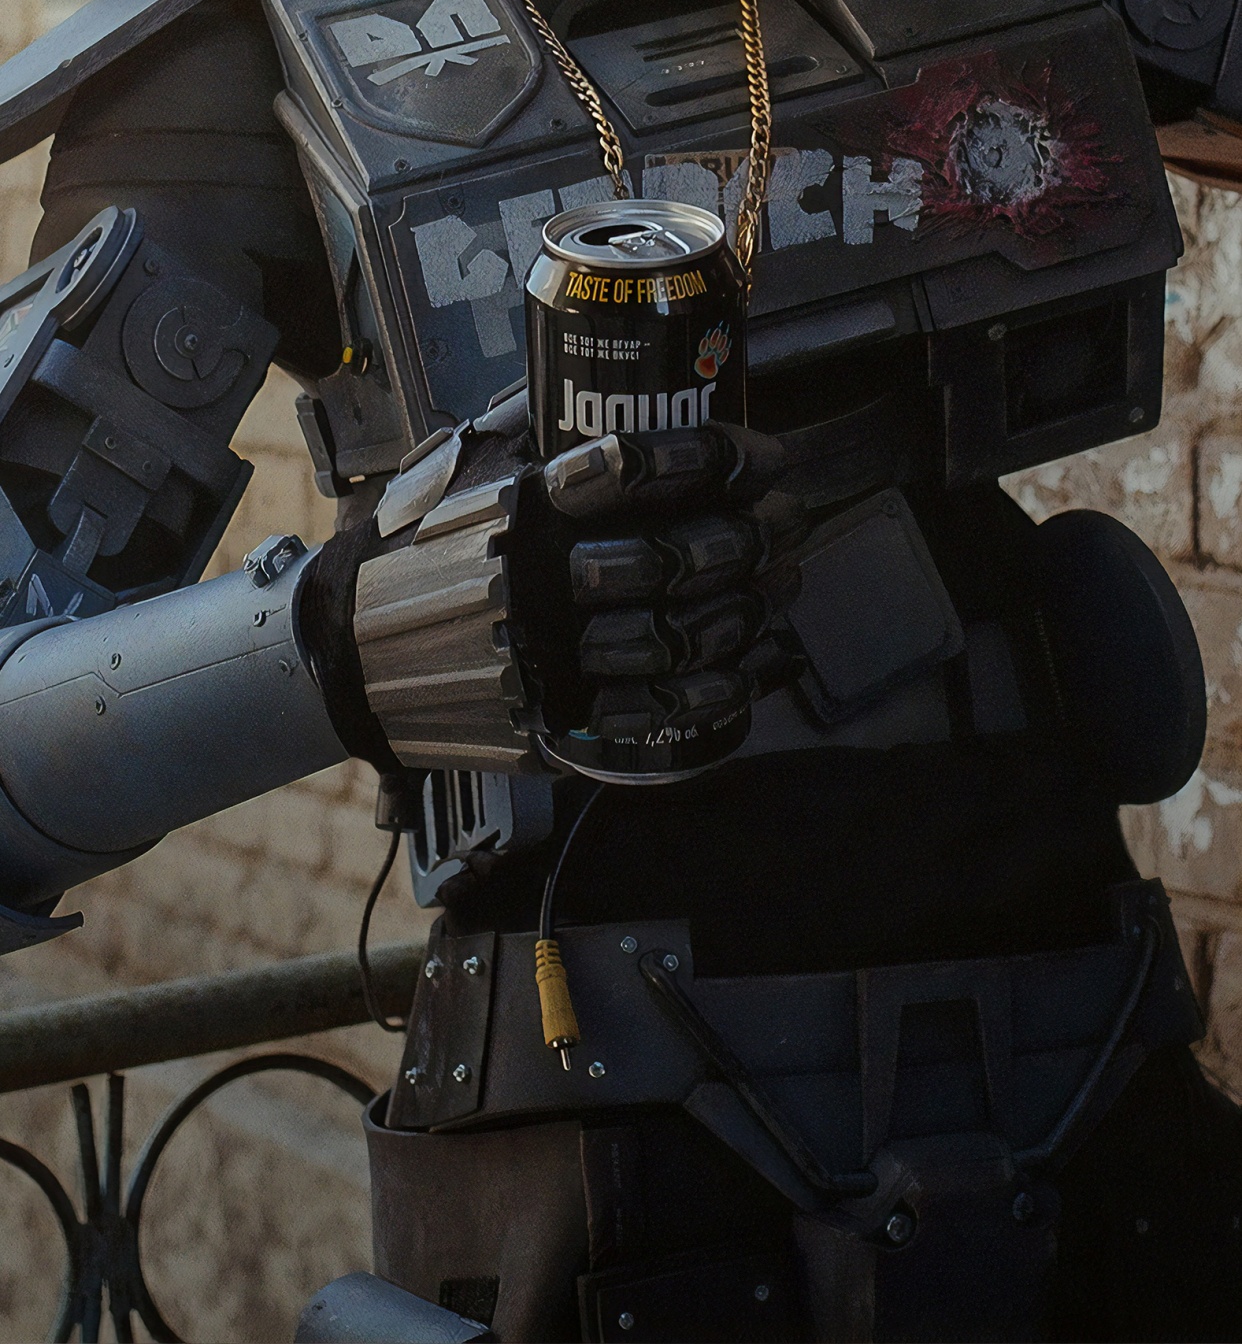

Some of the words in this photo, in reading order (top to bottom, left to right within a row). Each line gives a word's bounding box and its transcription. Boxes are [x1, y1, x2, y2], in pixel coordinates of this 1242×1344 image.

[565, 271, 609, 303] TASTE
[613, 278, 635, 304] OF
[637, 270, 708, 304] FREEDOM
